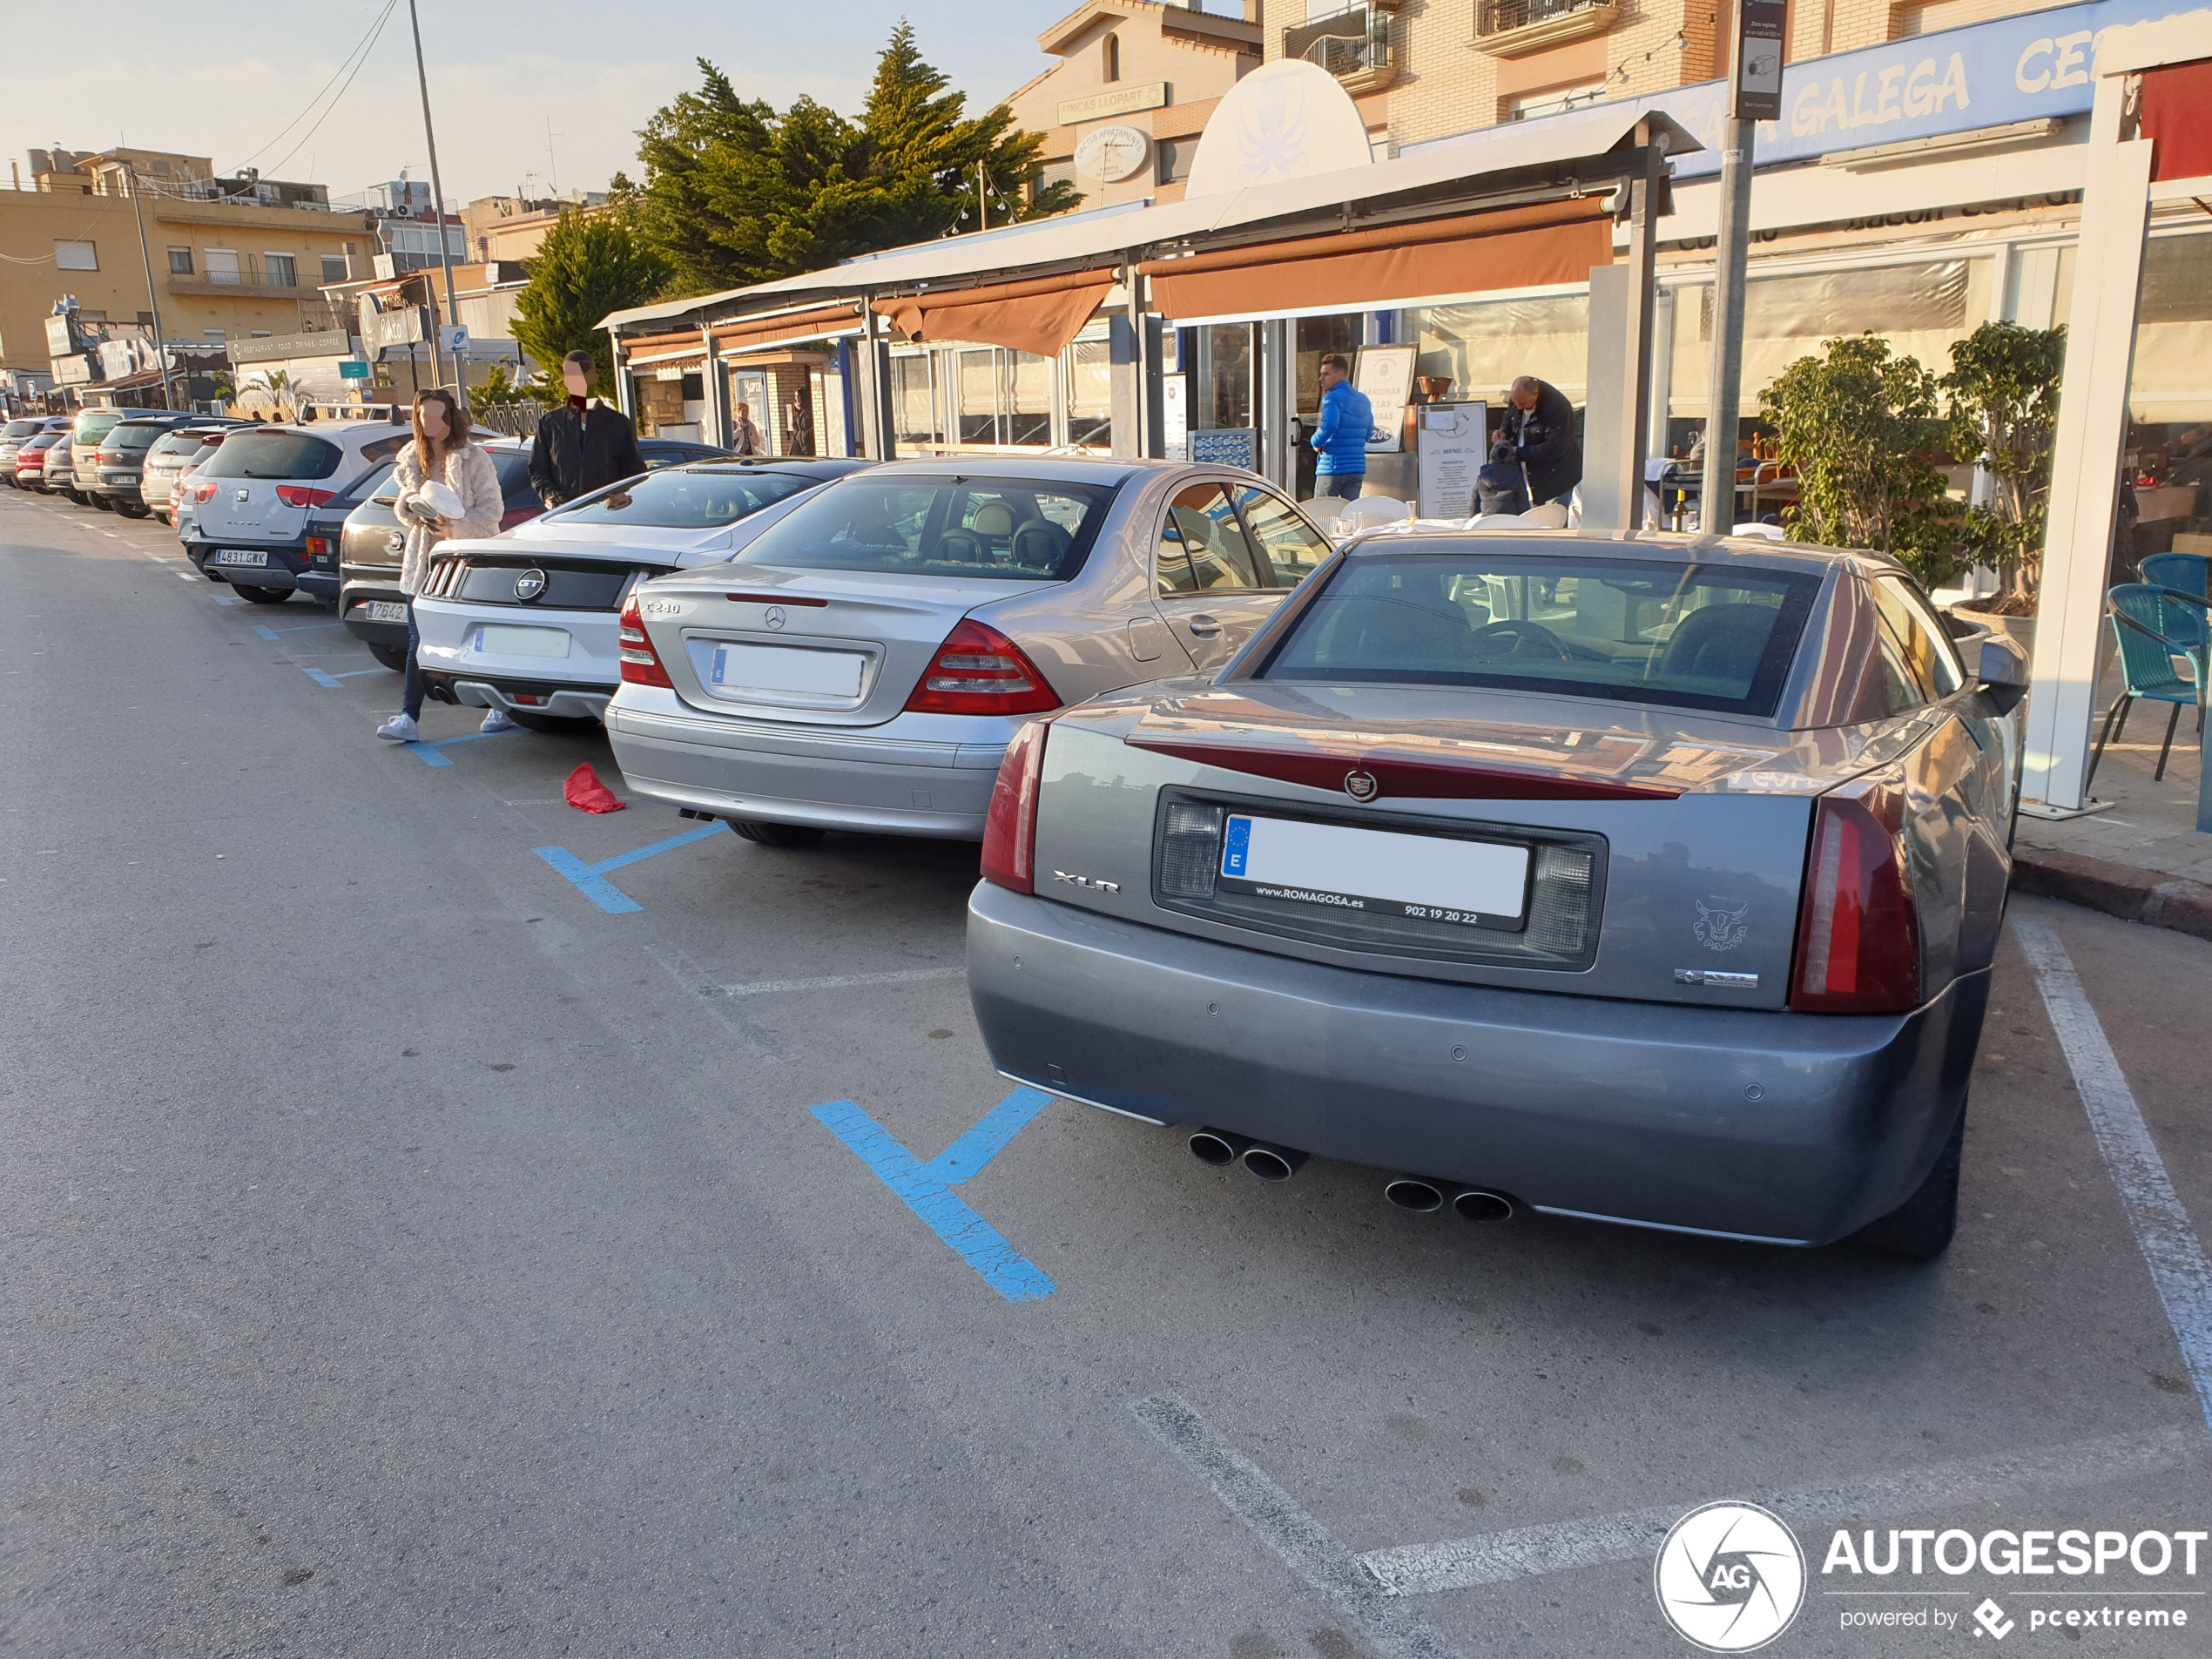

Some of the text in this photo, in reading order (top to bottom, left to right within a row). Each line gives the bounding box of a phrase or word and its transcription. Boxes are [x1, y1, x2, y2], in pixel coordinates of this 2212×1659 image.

[1791, 52, 1971, 138] GALEGA
[2014, 30, 2100, 95] CE
[1098, 90, 1143, 108] LLOPART
[1076, 133, 1098, 159] CACTUS
[381, 318, 402, 341] Punto
[244, 344, 273, 354] RESTAURANT
[295, 340, 315, 348] DRINKS
[1363, 388, 1401, 396] SARDINAS
[221, 550, 265, 564] 4831 GWK
[517, 578, 542, 589] GT
[374, 604, 404, 620] 7642
[1231, 853, 1242, 868] E
[1052, 869, 1121, 895] XLR
[1256, 886, 1365, 909] www.ROMAGOSA.es
[1405, 904, 1478, 924] 902 19 20 22
